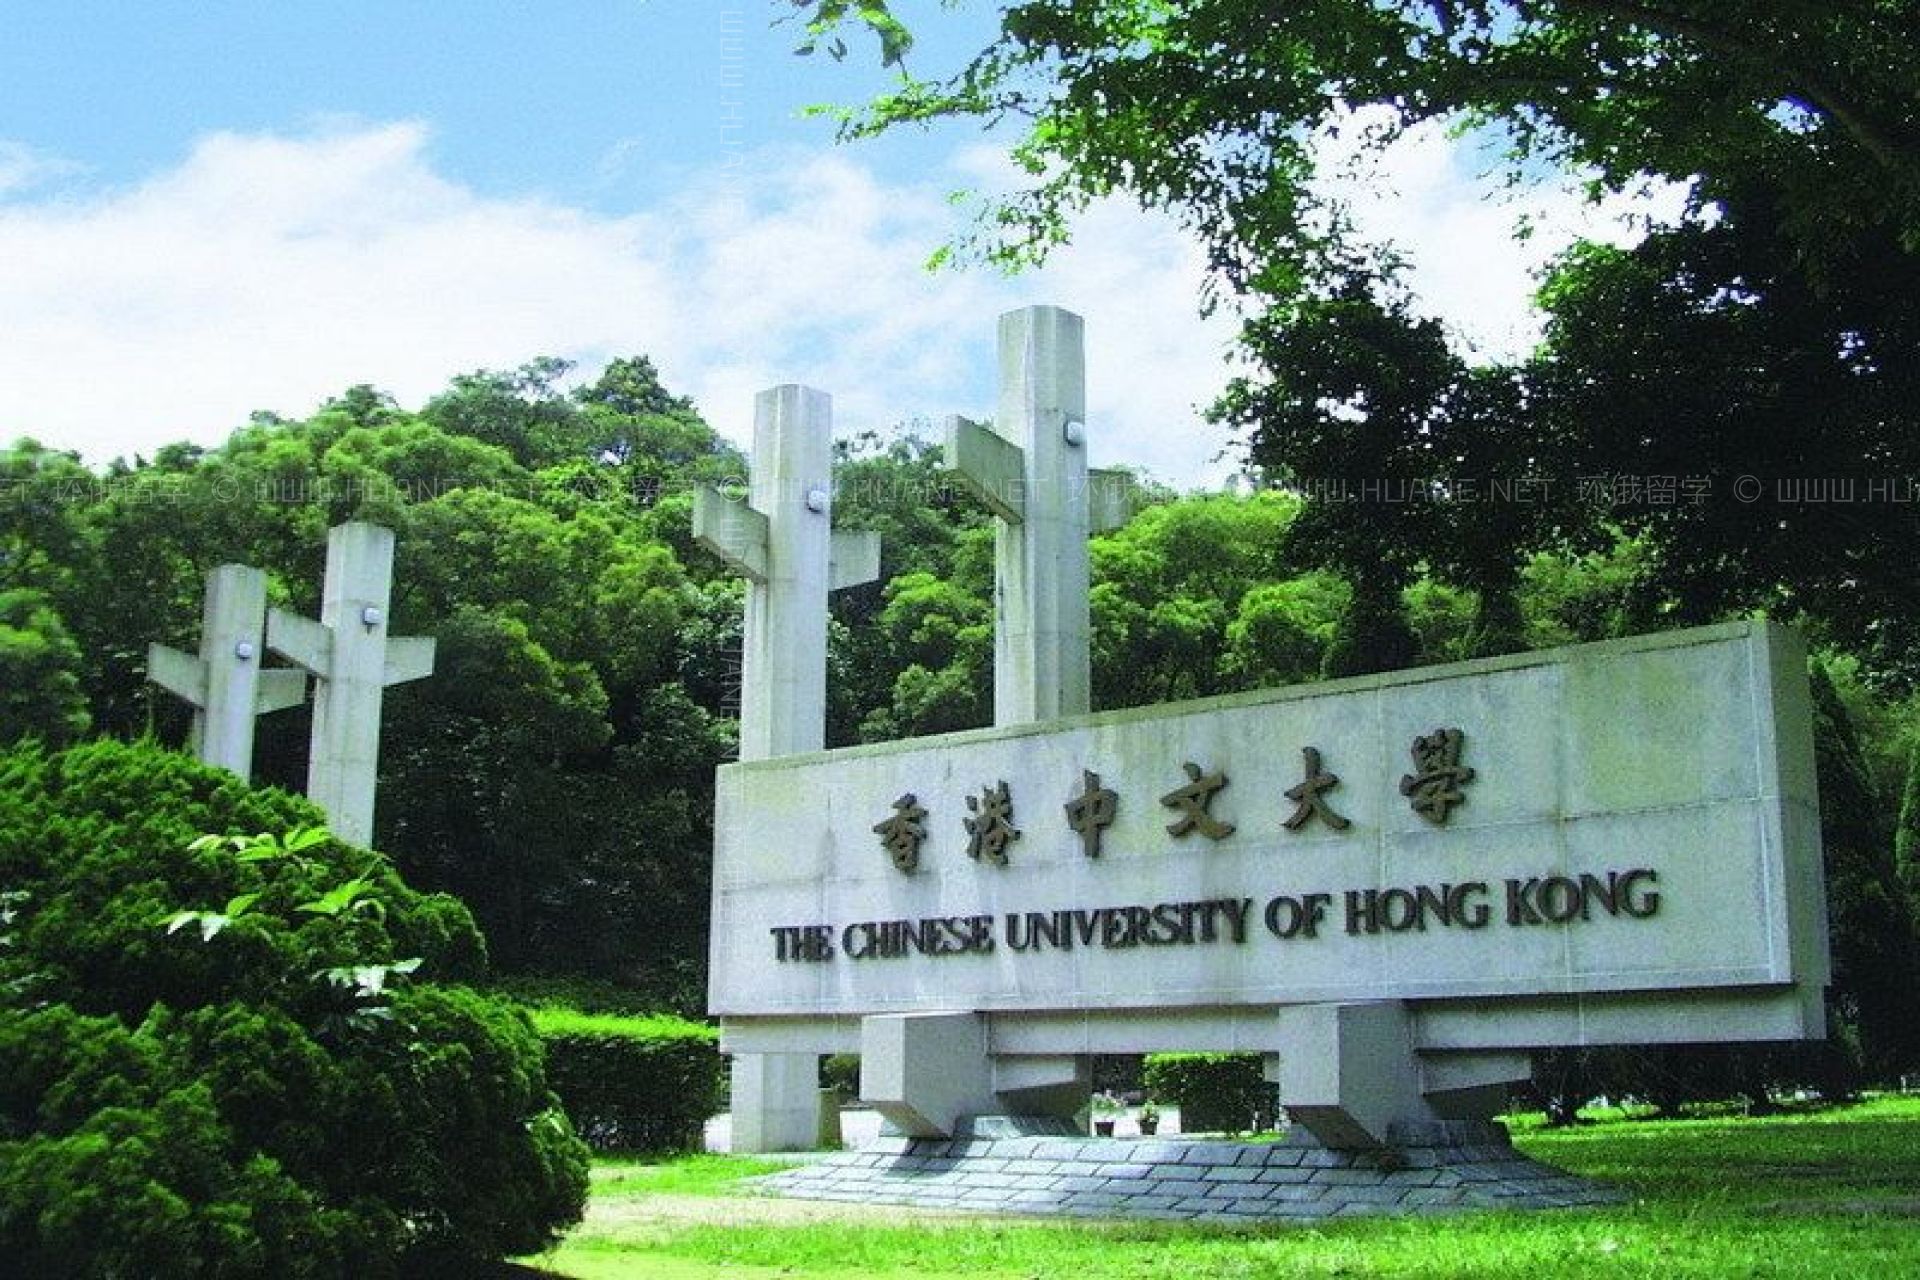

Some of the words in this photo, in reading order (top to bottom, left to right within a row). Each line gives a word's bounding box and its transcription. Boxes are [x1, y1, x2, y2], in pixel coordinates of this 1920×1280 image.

[873, 729, 1475, 875] 香港中文大學
[770, 925, 834, 963] THE
[841, 915, 996, 961] CHINESE
[1005, 897, 1253, 952] UNIVERSITY
[1264, 893, 1331, 939] OF
[1343, 882, 1489, 937] HONG
[1505, 869, 1661, 927] KONG
